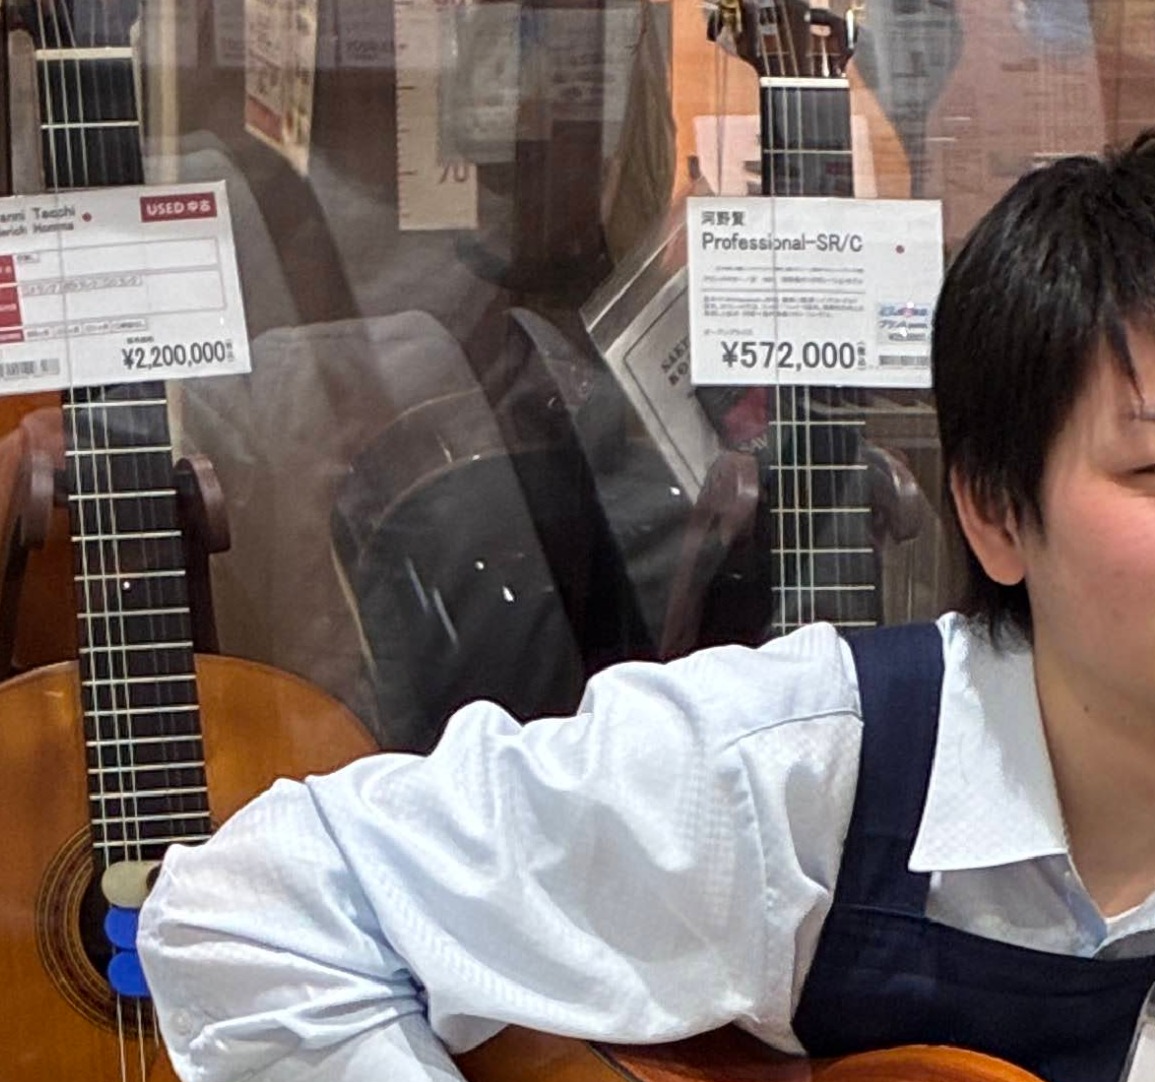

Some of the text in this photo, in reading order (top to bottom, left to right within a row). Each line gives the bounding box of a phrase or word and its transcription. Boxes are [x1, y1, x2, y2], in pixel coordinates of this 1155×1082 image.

[146, 202, 184, 216] USED
[122, 340, 226, 371] ¥2,200,000
[721, 341, 855, 371] ¥572,000
